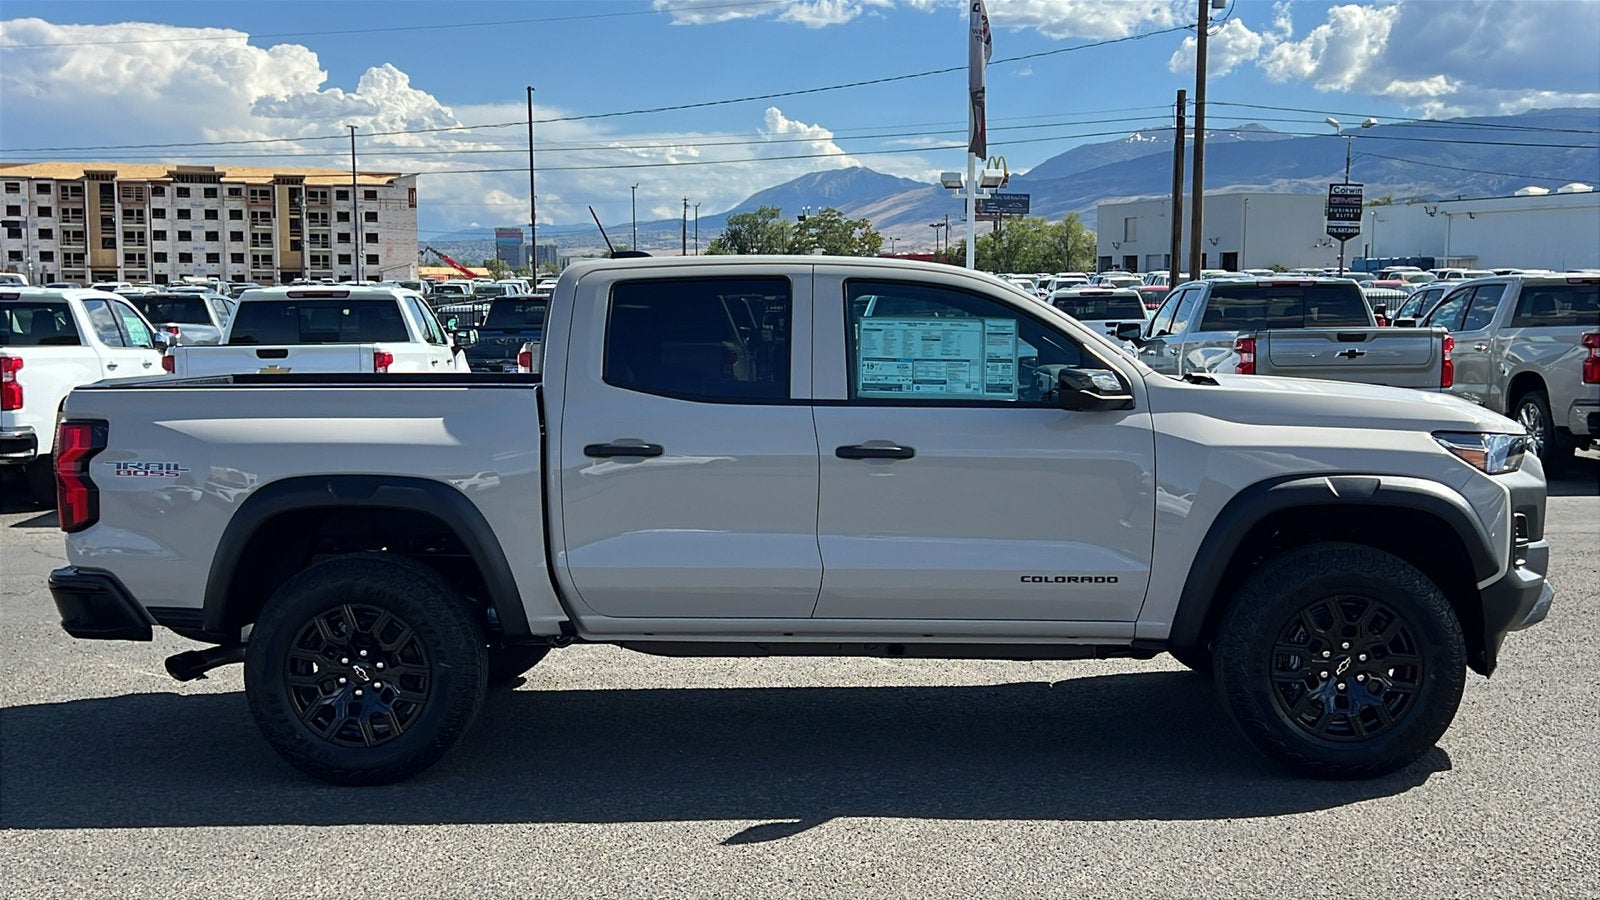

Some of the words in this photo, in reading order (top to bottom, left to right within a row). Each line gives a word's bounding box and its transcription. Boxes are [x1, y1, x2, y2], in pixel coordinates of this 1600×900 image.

[1333, 186, 1362, 194] Corwin
[104, 462, 189, 471] TRAIL
[1020, 575, 1119, 583] COLORADO
